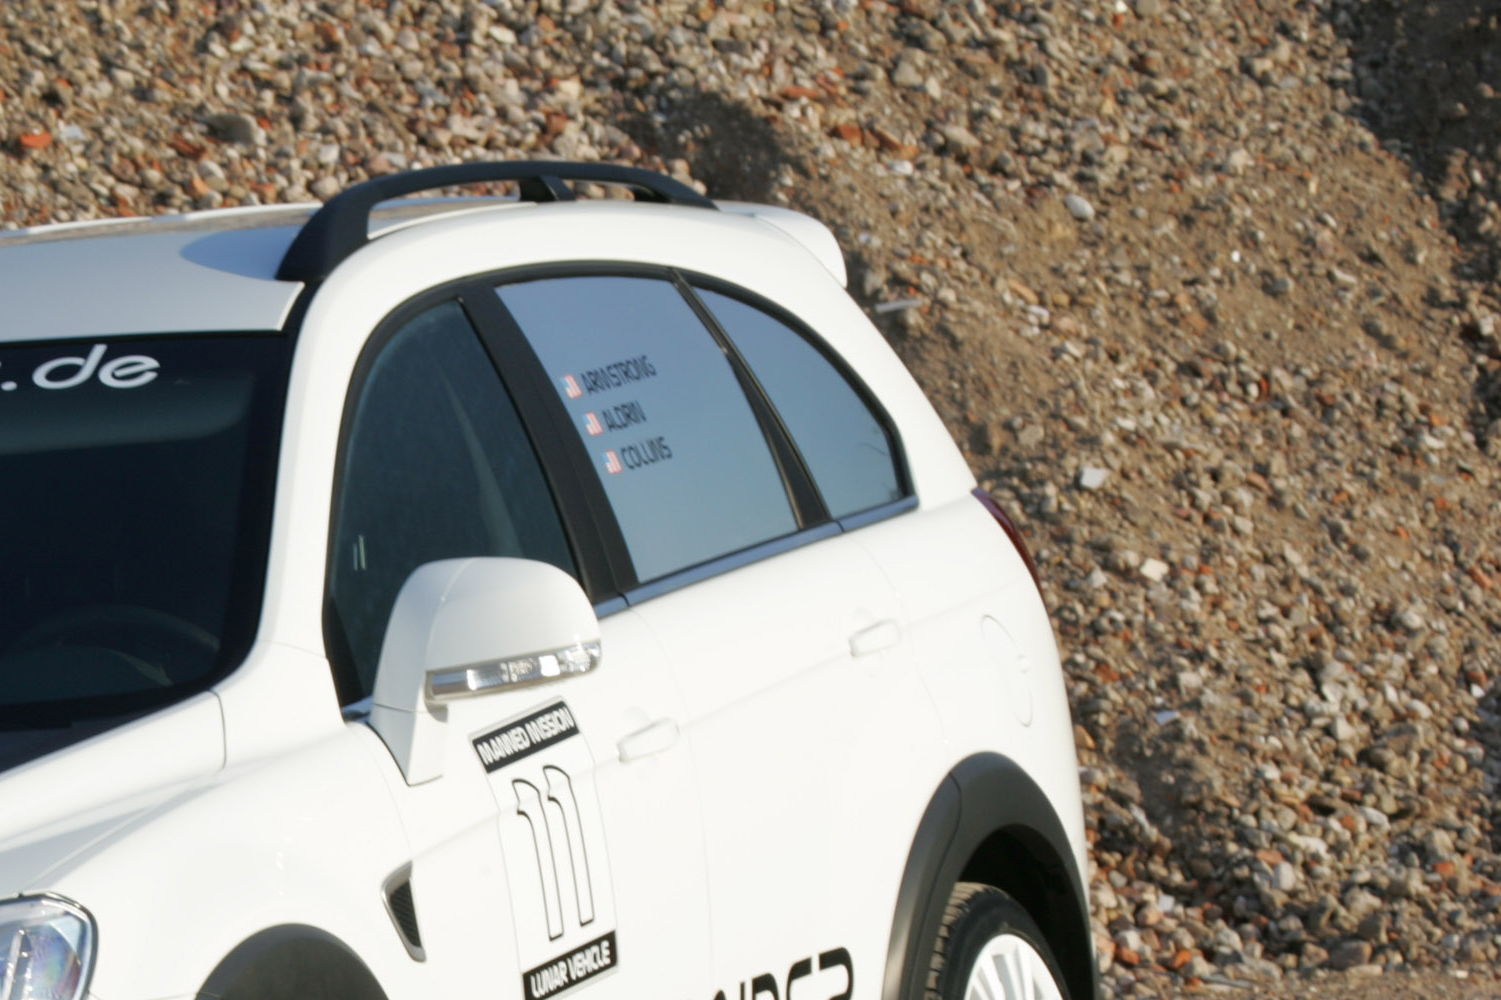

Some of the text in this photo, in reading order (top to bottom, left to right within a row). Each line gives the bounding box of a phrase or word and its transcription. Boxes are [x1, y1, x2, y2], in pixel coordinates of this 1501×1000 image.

[580, 355, 657, 395] ARMSTRONG
[602, 401, 647, 432] ALDRIN
[621, 436, 673, 470] COLLINS
[476, 705, 574, 766] MANNED MISSION
[530, 940, 611, 998] LUNAR VEHICLE
